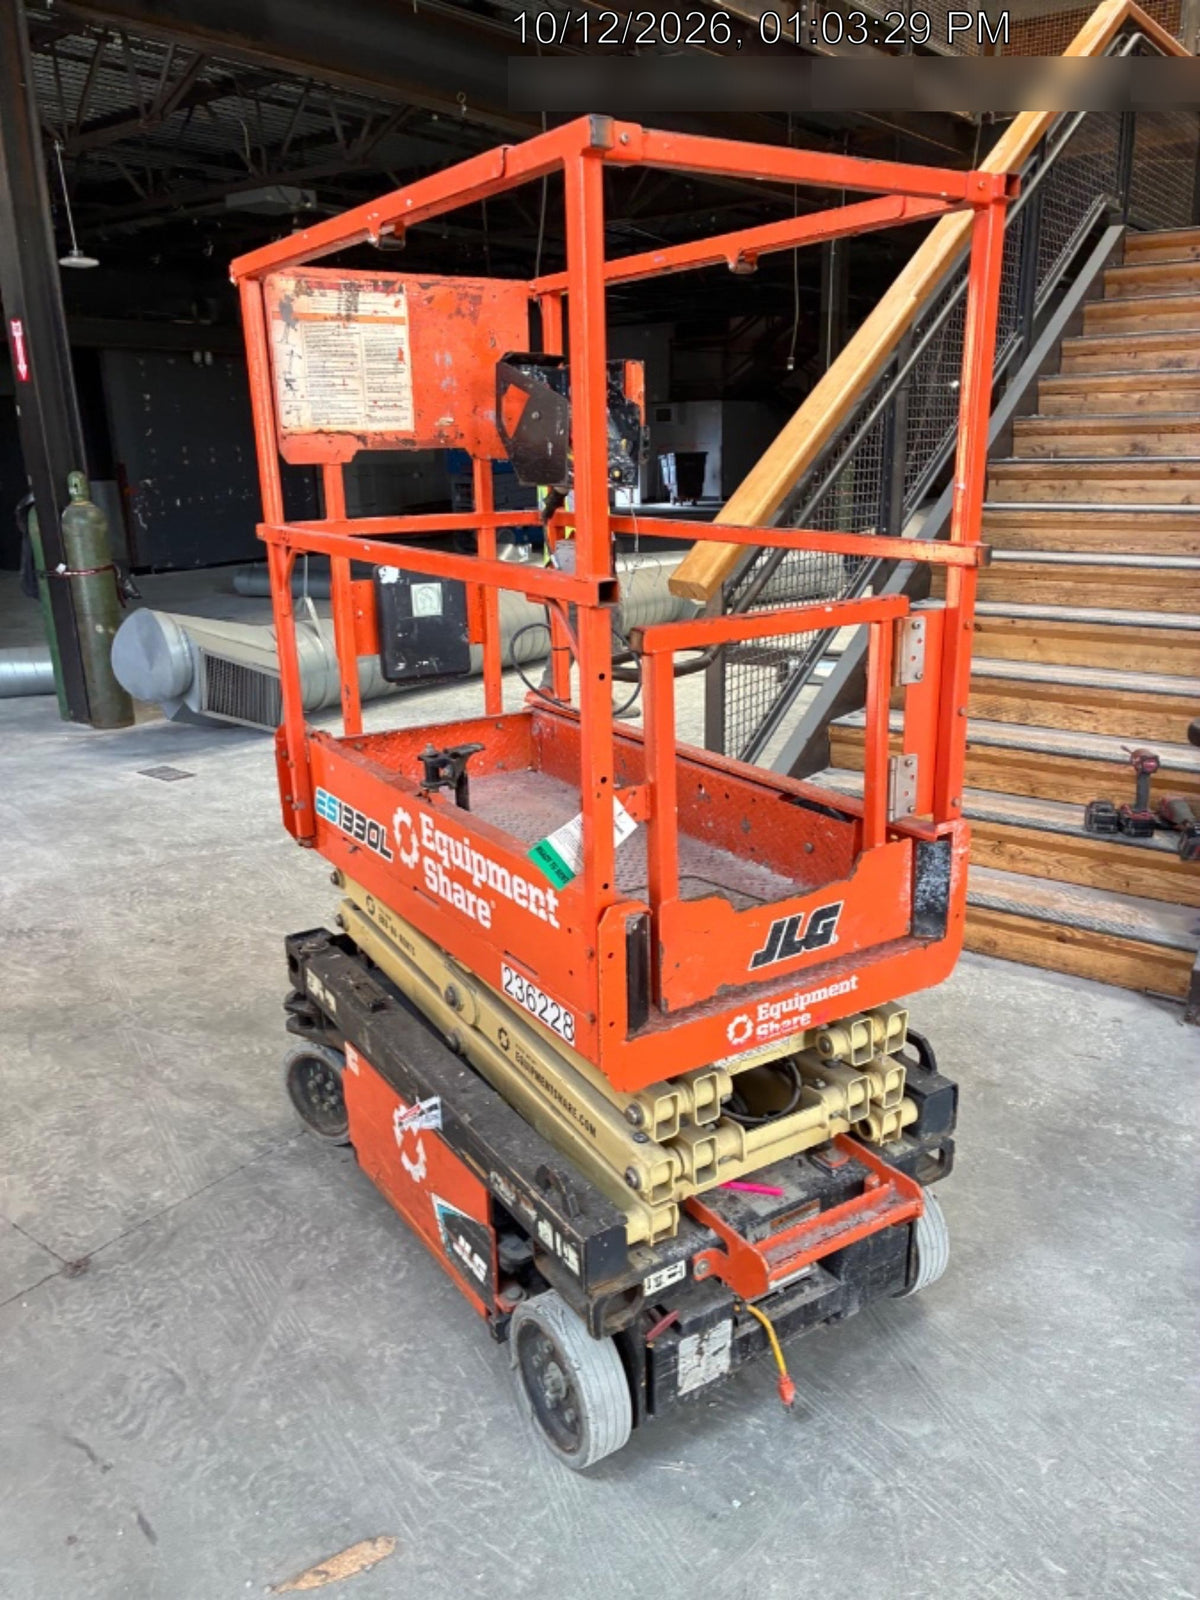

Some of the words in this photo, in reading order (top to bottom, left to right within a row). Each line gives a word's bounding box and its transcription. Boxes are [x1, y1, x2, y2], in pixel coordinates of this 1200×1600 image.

[316, 787, 392, 860] ES1330L
[419, 812, 560, 929] Equipment
[423, 855, 491, 929] Share
[748, 900, 844, 970] JLG
[503, 965, 575, 1043] 236228
[756, 1012, 812, 1039] Share
[757, 974, 859, 1022] Equipment
